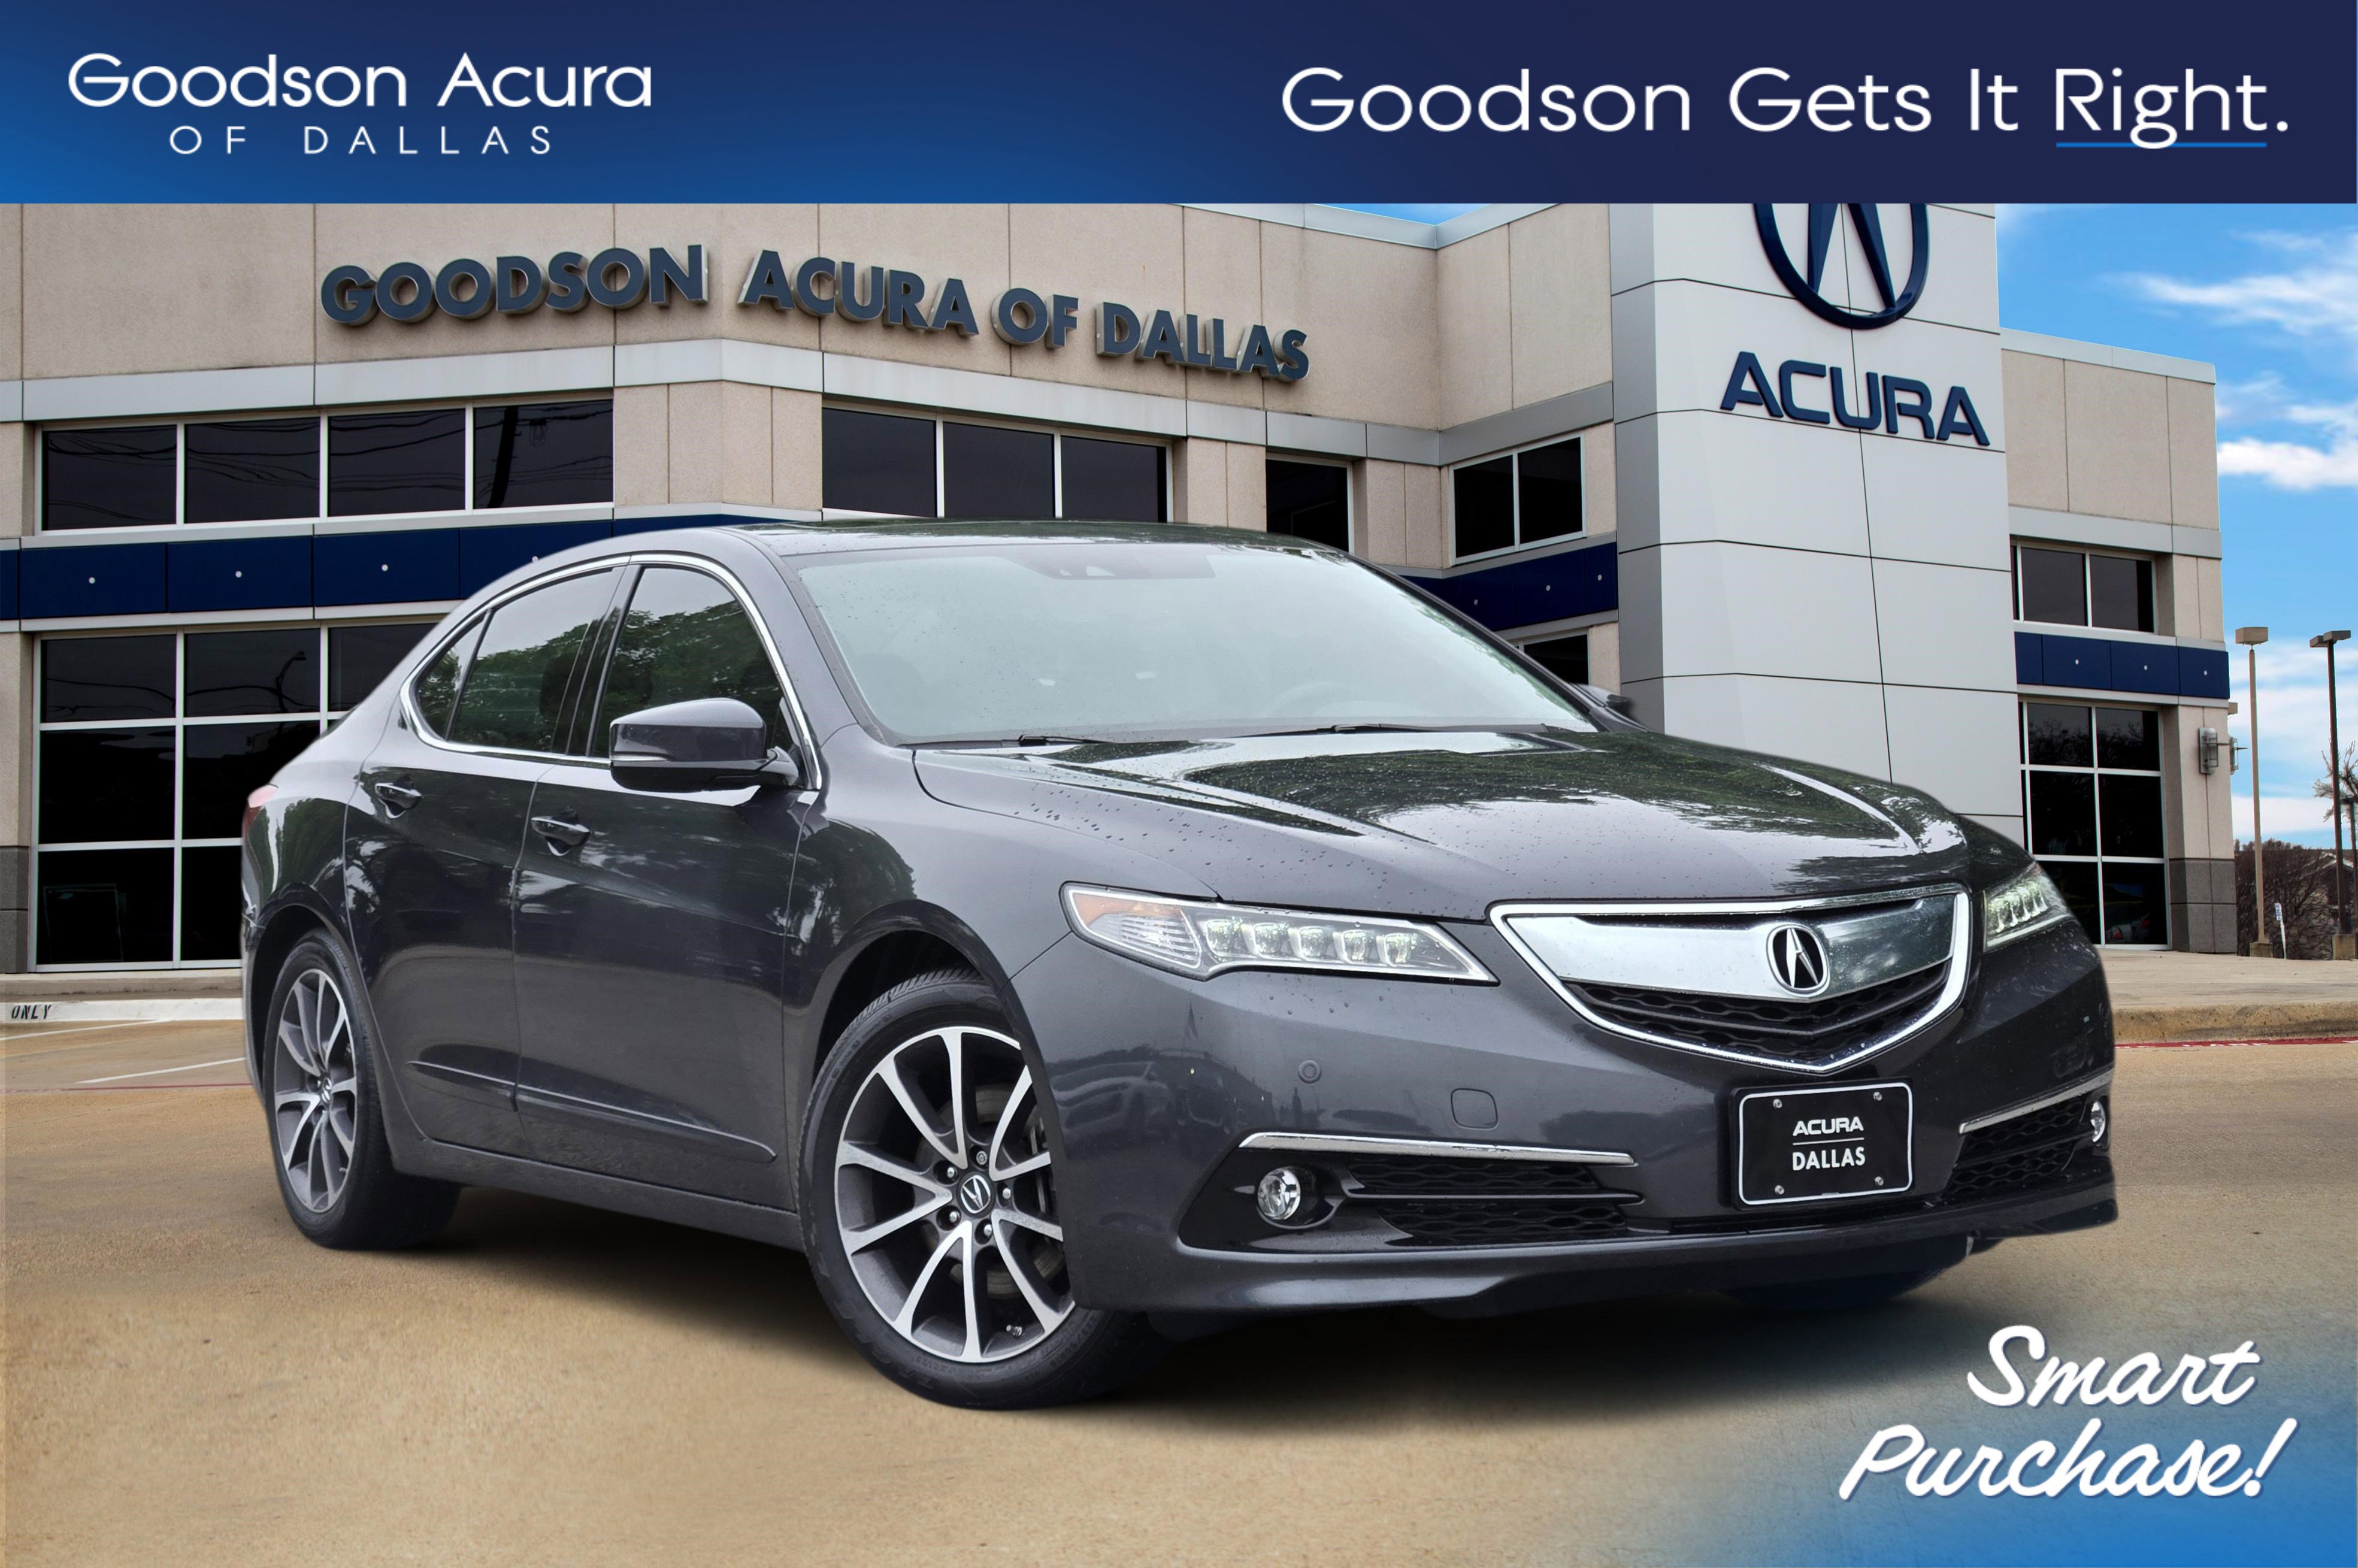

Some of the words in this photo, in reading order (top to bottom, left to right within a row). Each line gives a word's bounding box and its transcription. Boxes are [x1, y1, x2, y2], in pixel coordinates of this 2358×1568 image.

[320, 244, 709, 325] GOODSON
[738, 249, 979, 337] ACURA
[991, 287, 1078, 349] OF
[1095, 301, 1309, 382] DALLAS
[1720, 351, 1991, 447] ACURA
[11, 1004, 52, 1019] ONLY
[1793, 1116, 1864, 1137] ACURA
[1792, 1146, 1866, 1171] DALLAS
